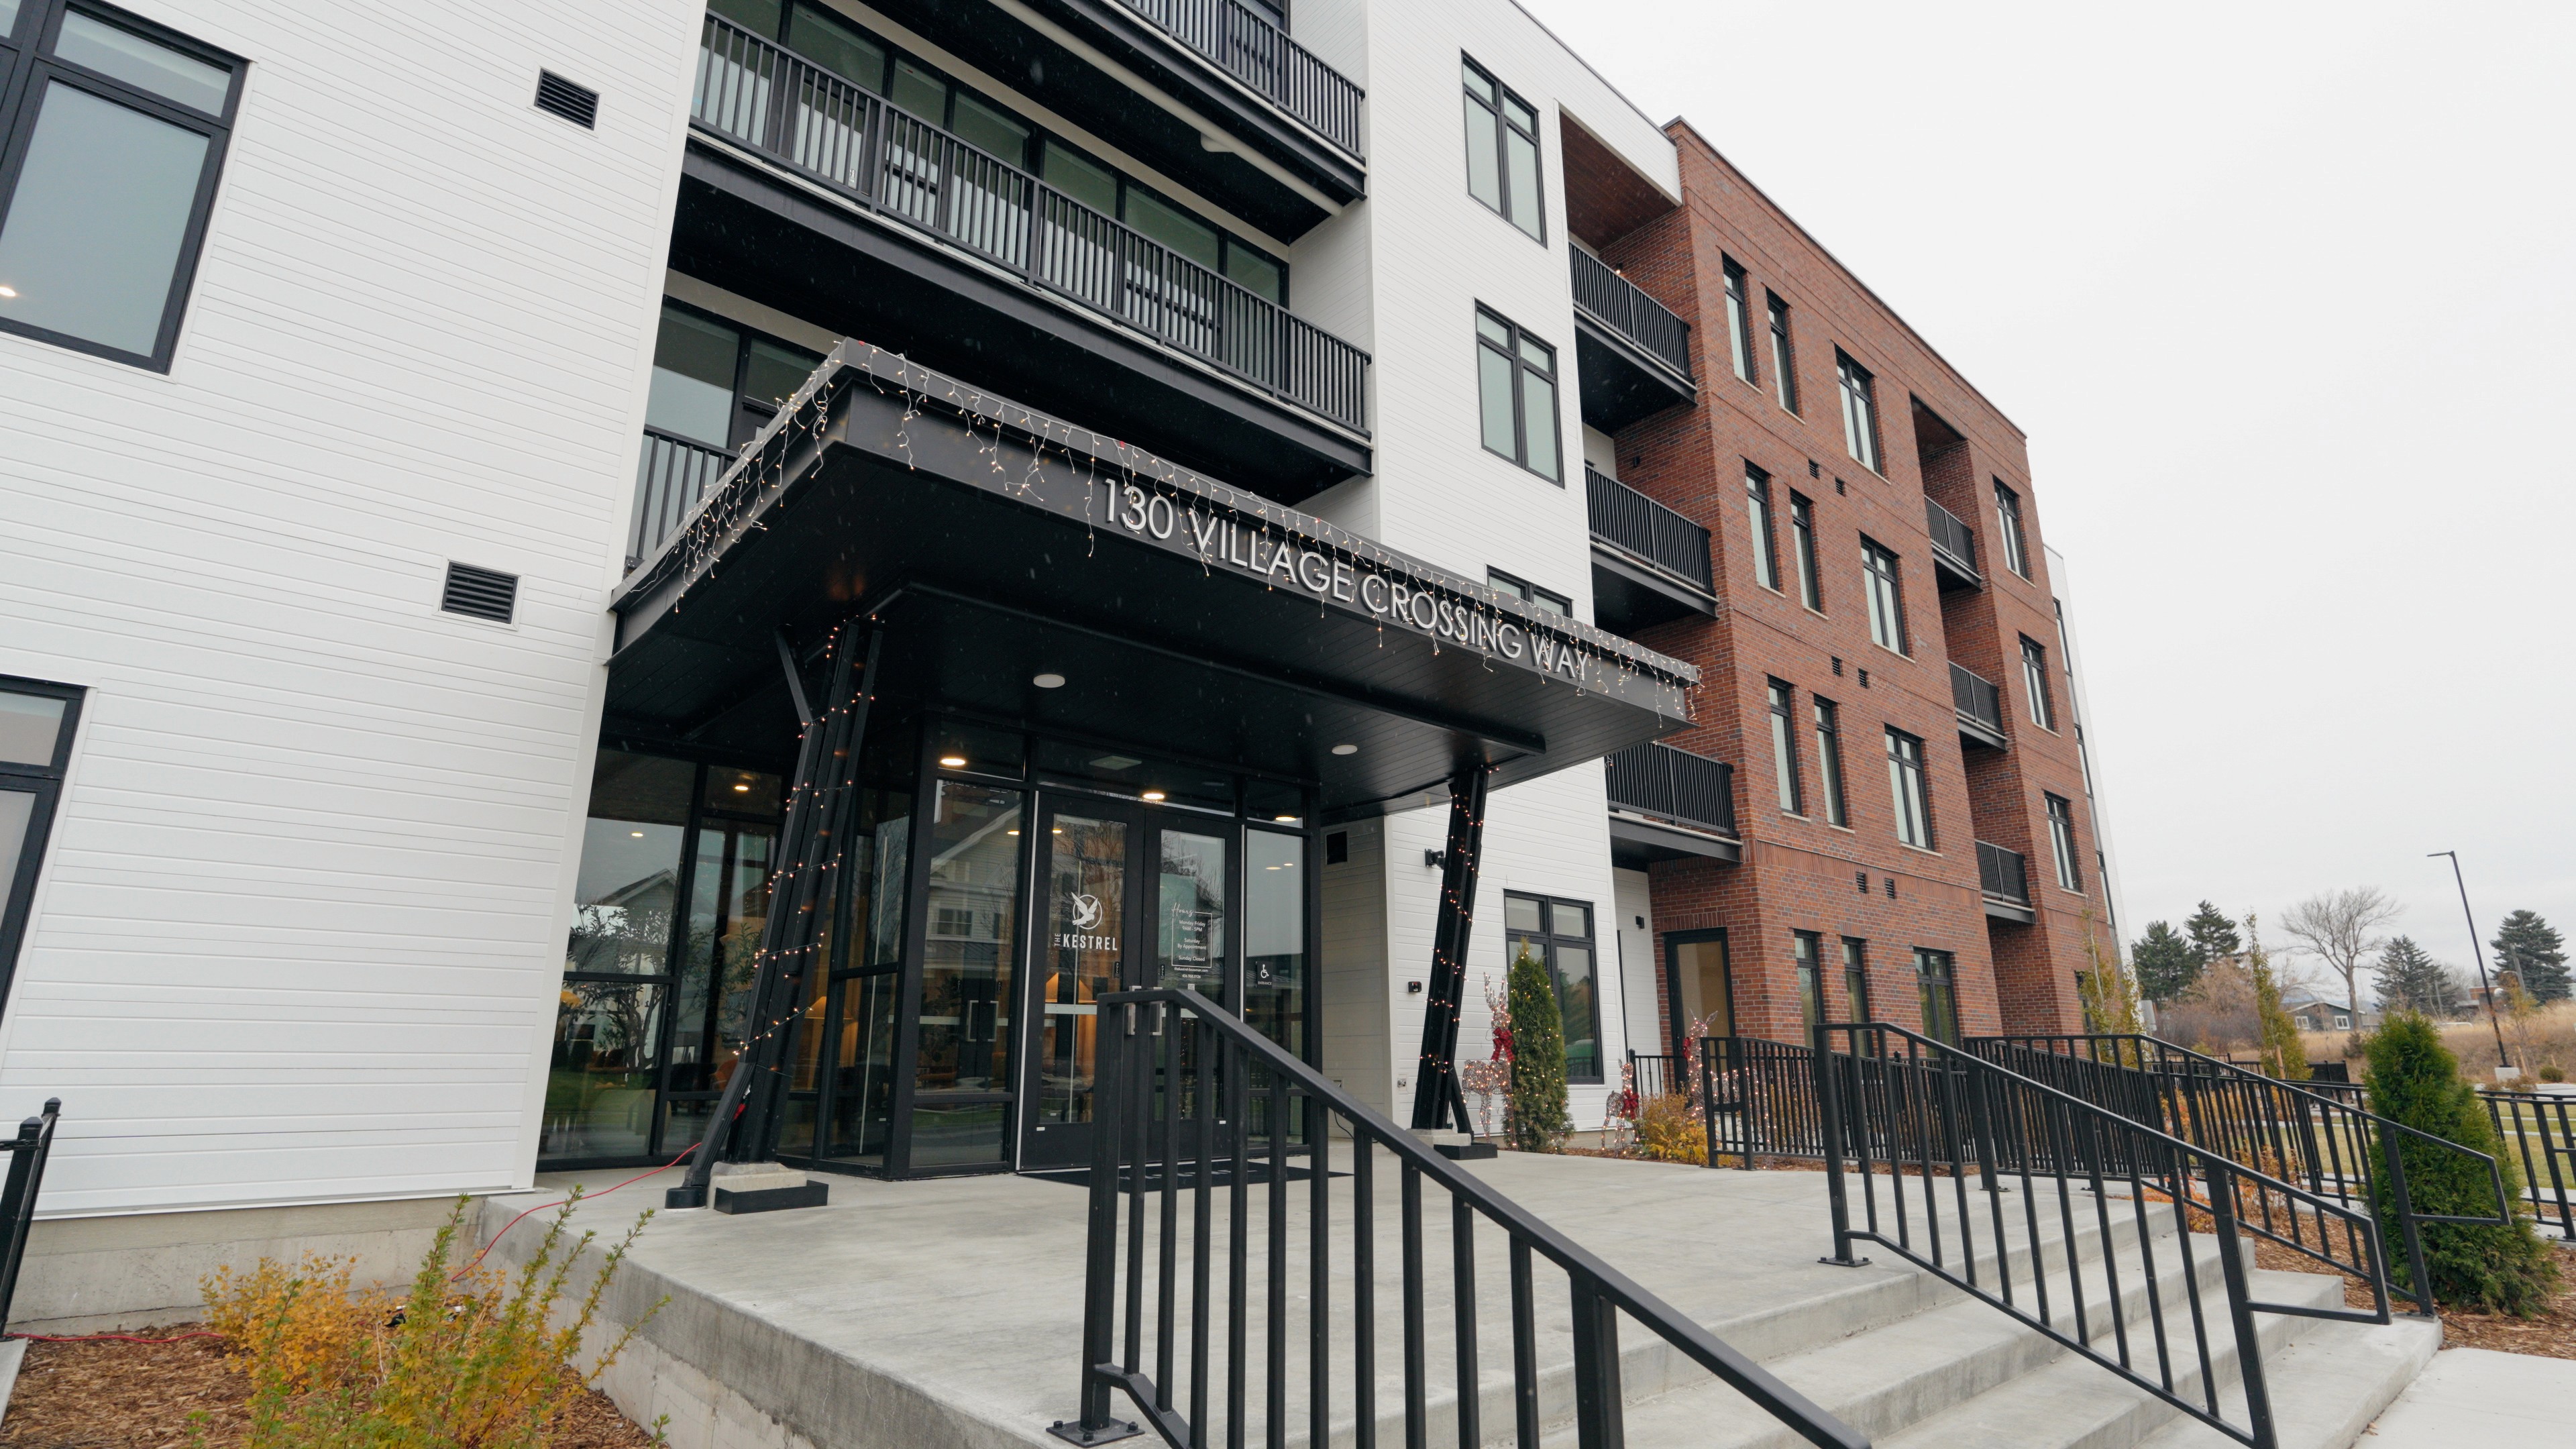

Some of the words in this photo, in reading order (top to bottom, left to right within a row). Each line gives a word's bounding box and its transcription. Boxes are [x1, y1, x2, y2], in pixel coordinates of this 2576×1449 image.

[1104, 478, 1173, 539] 130
[1189, 507, 1351, 602] VILLAGE
[1361, 574, 1522, 659] CROSSING
[1529, 632, 1589, 681] WAY
[1171, 902, 1193, 917] Hours
[1063, 933, 1118, 951] KESTREL
